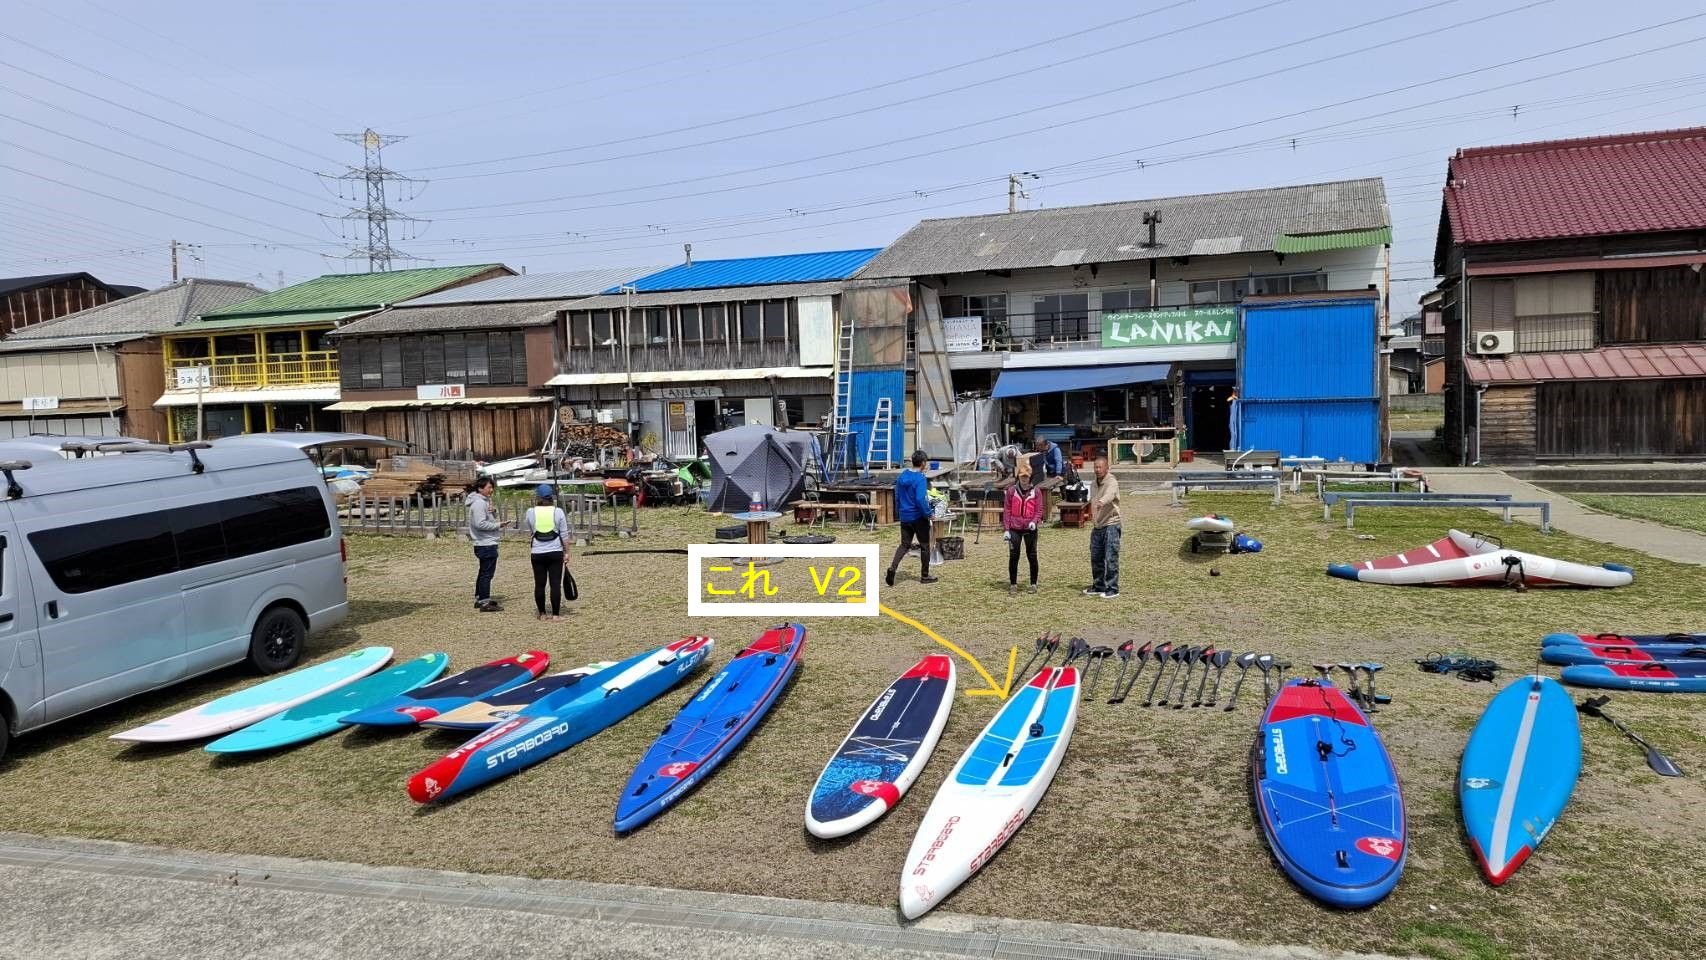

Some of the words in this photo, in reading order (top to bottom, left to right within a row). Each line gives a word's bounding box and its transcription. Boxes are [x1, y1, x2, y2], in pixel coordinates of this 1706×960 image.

[1110, 319, 1232, 344] LANIKAI
[660, 389, 712, 399] LANIKAI
[486, 722, 569, 770] STARBOARD
[913, 815, 961, 876] STARBOARD
[969, 808, 1025, 874] STARBOARD
